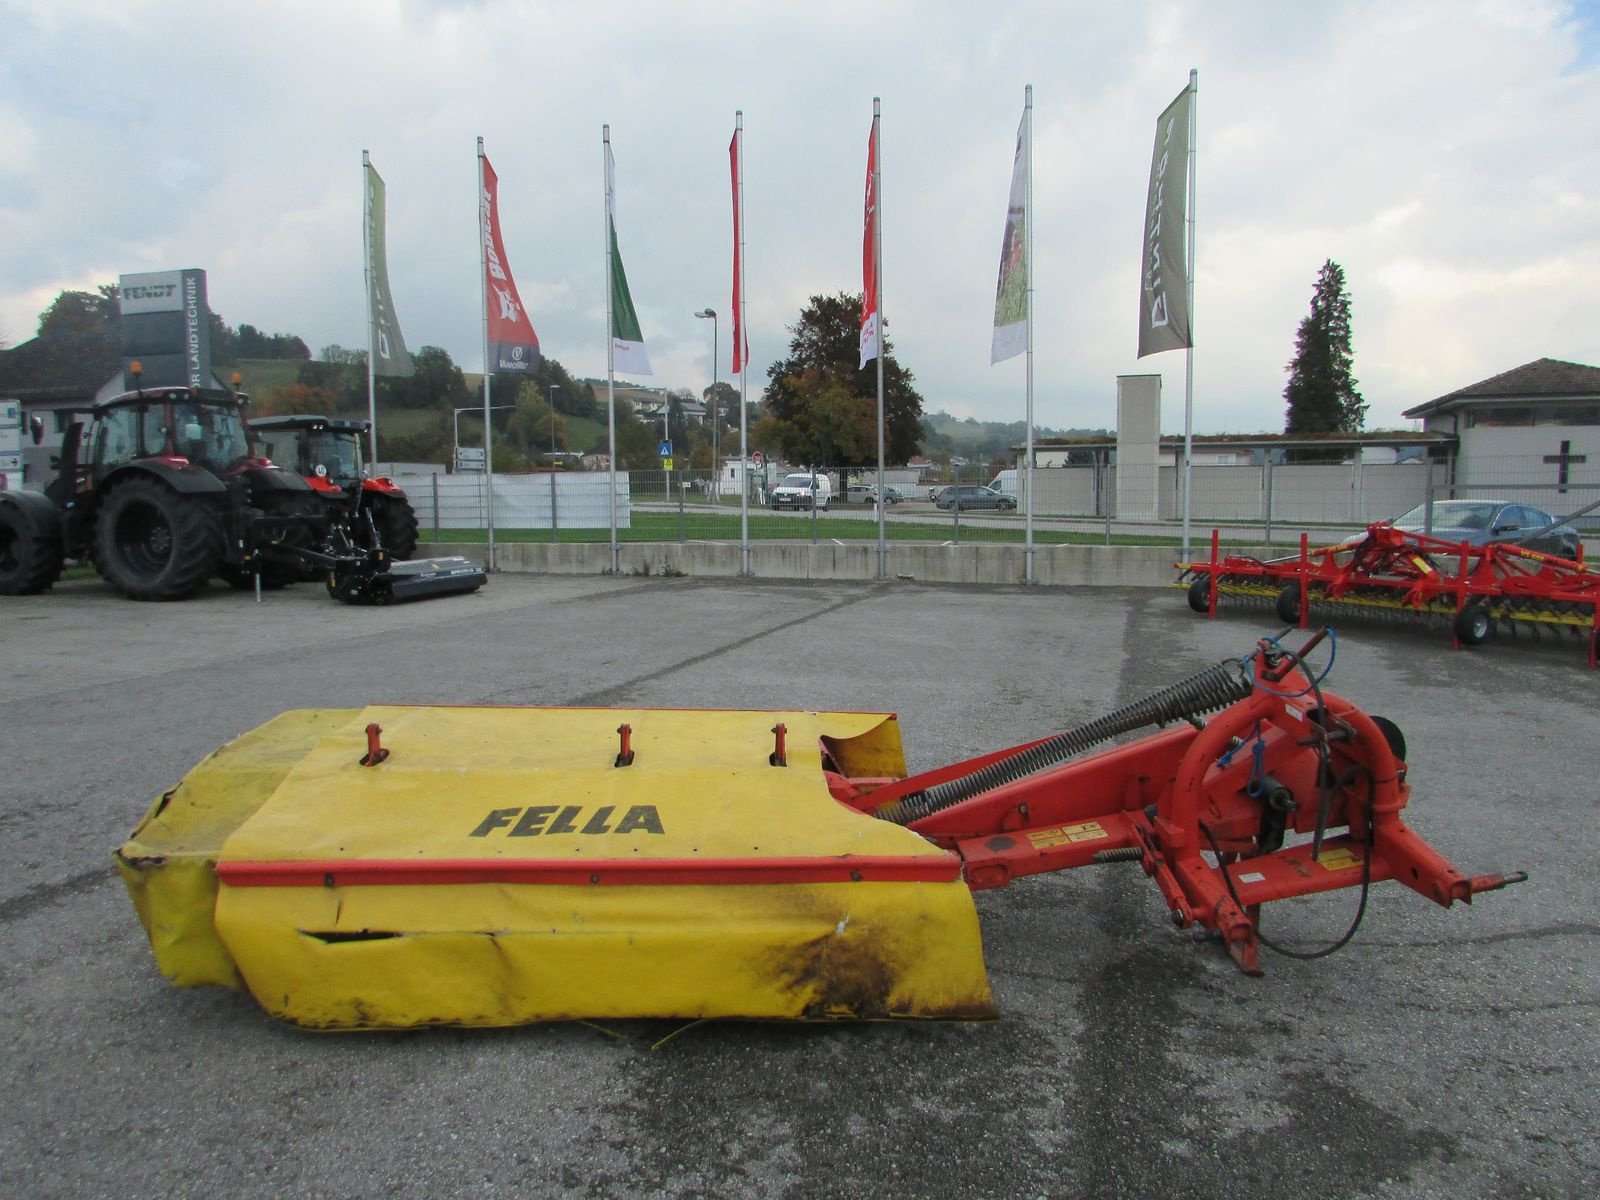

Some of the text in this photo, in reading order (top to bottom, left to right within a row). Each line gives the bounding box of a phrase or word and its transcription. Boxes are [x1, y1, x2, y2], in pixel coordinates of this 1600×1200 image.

[123, 284, 177, 300] FENDT
[186, 277, 200, 371] LANDTECHNIK
[468, 805, 665, 837] FELLA
